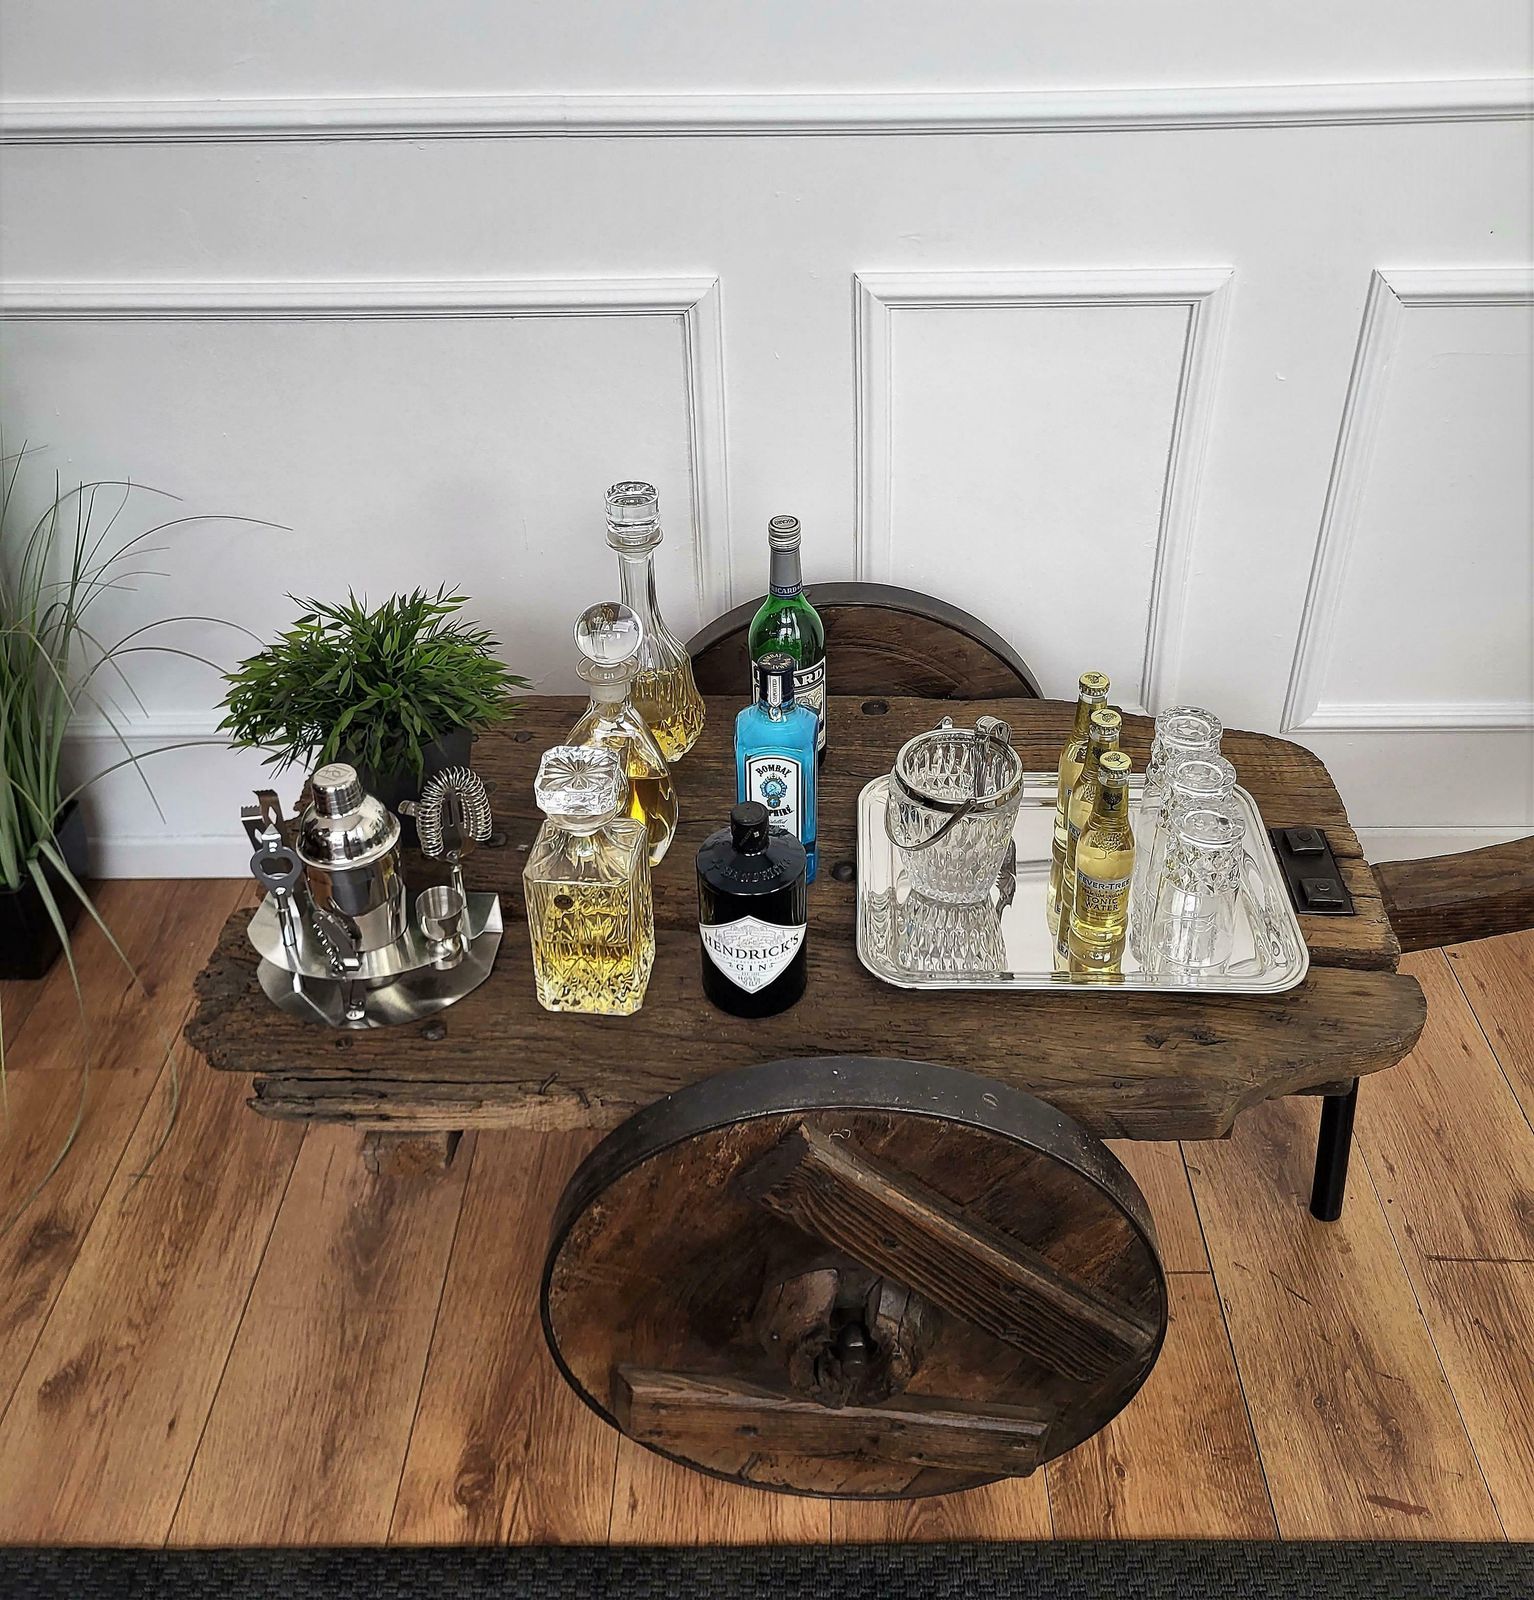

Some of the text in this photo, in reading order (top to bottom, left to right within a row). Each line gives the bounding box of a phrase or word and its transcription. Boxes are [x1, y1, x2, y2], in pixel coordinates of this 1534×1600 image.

[755, 764, 792, 778] BOMBAY
[768, 804, 794, 817] PHIRE
[1086, 895, 1119, 905] TONIC
[1085, 902, 1119, 911] WATER
[703, 931, 800, 960] HENDRICK'S
[736, 964, 767, 972] GIN
